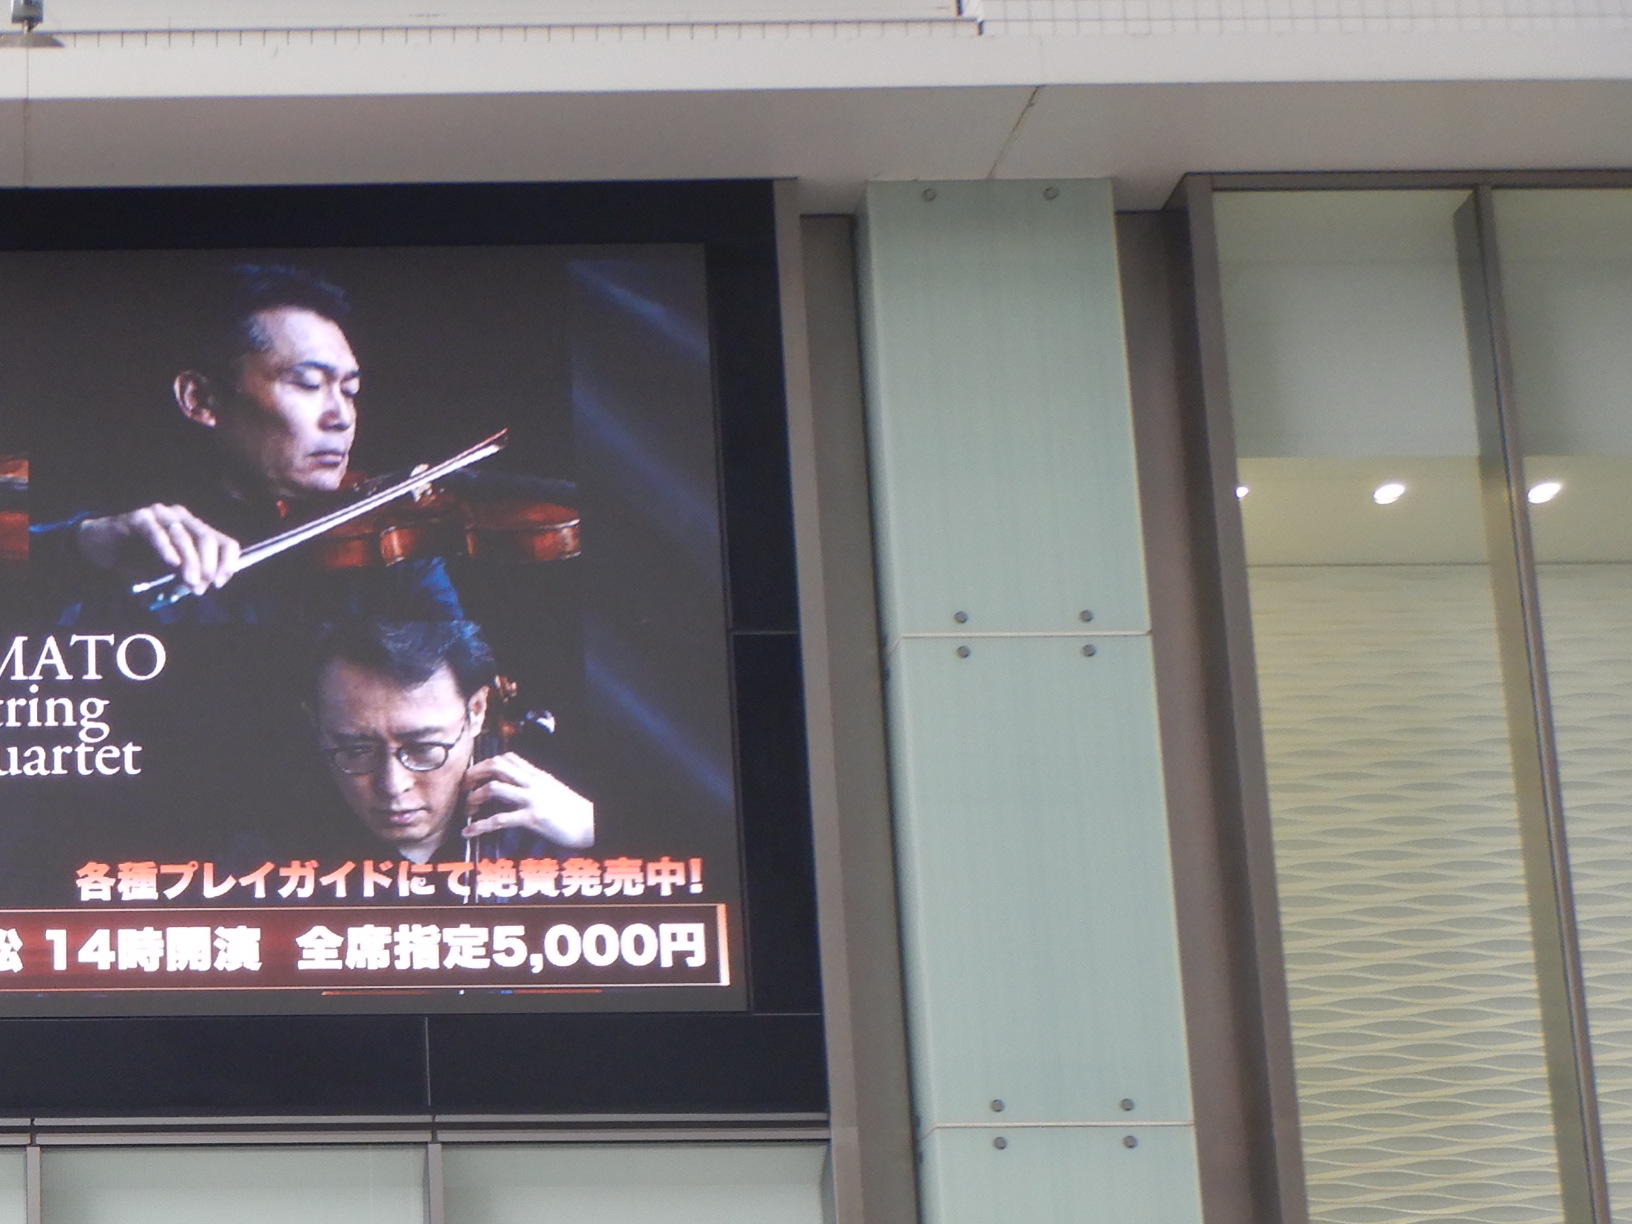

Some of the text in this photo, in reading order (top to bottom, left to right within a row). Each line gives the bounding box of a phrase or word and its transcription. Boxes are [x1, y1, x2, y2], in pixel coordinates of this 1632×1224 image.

[45, 926, 262, 972] 14時開演
[295, 923, 707, 974] 全席指定5,000円
